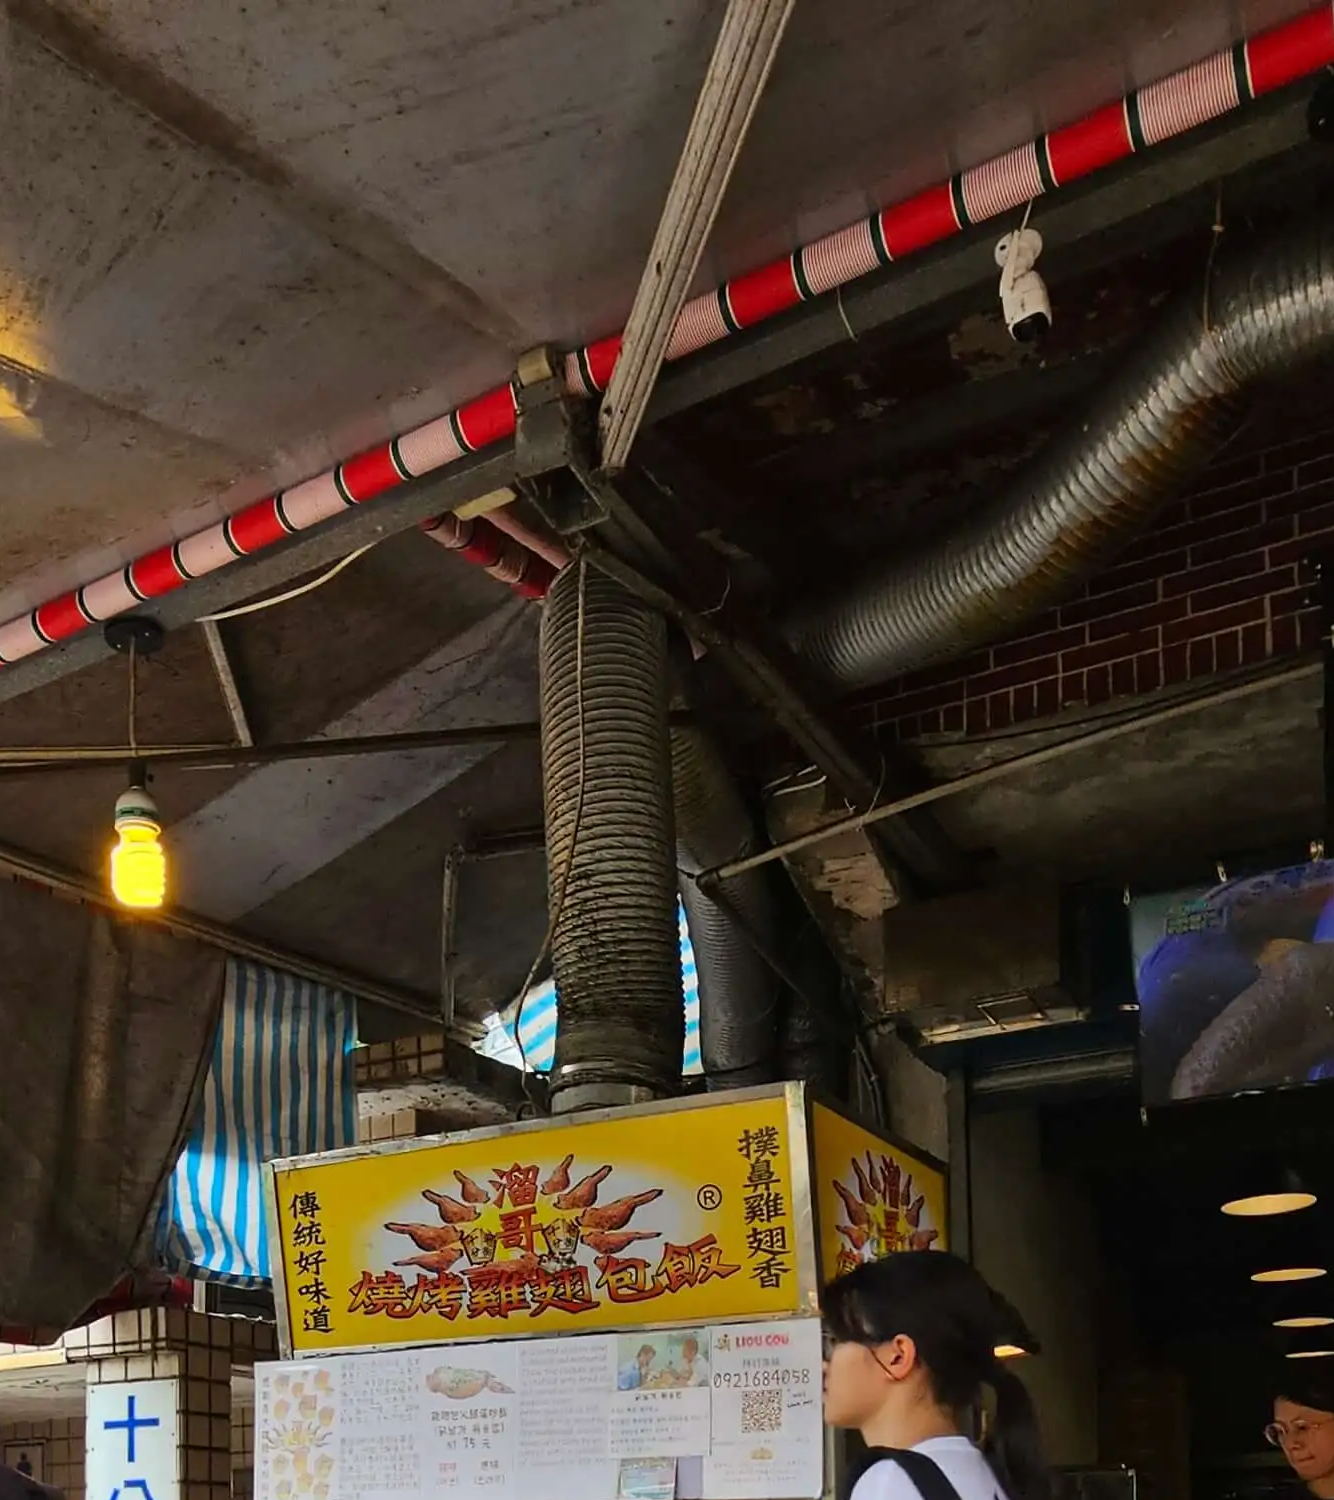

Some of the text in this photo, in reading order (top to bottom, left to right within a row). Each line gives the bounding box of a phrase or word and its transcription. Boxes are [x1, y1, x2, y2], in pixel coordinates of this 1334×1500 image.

[487, 1162, 543, 1256] 溜哥
[736, 1126, 793, 1291] 撲鼻雞翅香
[288, 1191, 335, 1334] 傳統好味道
[347, 1233, 742, 1321] 燒烤雞翅包飯
[713, 1368, 811, 1390] 0921684058
